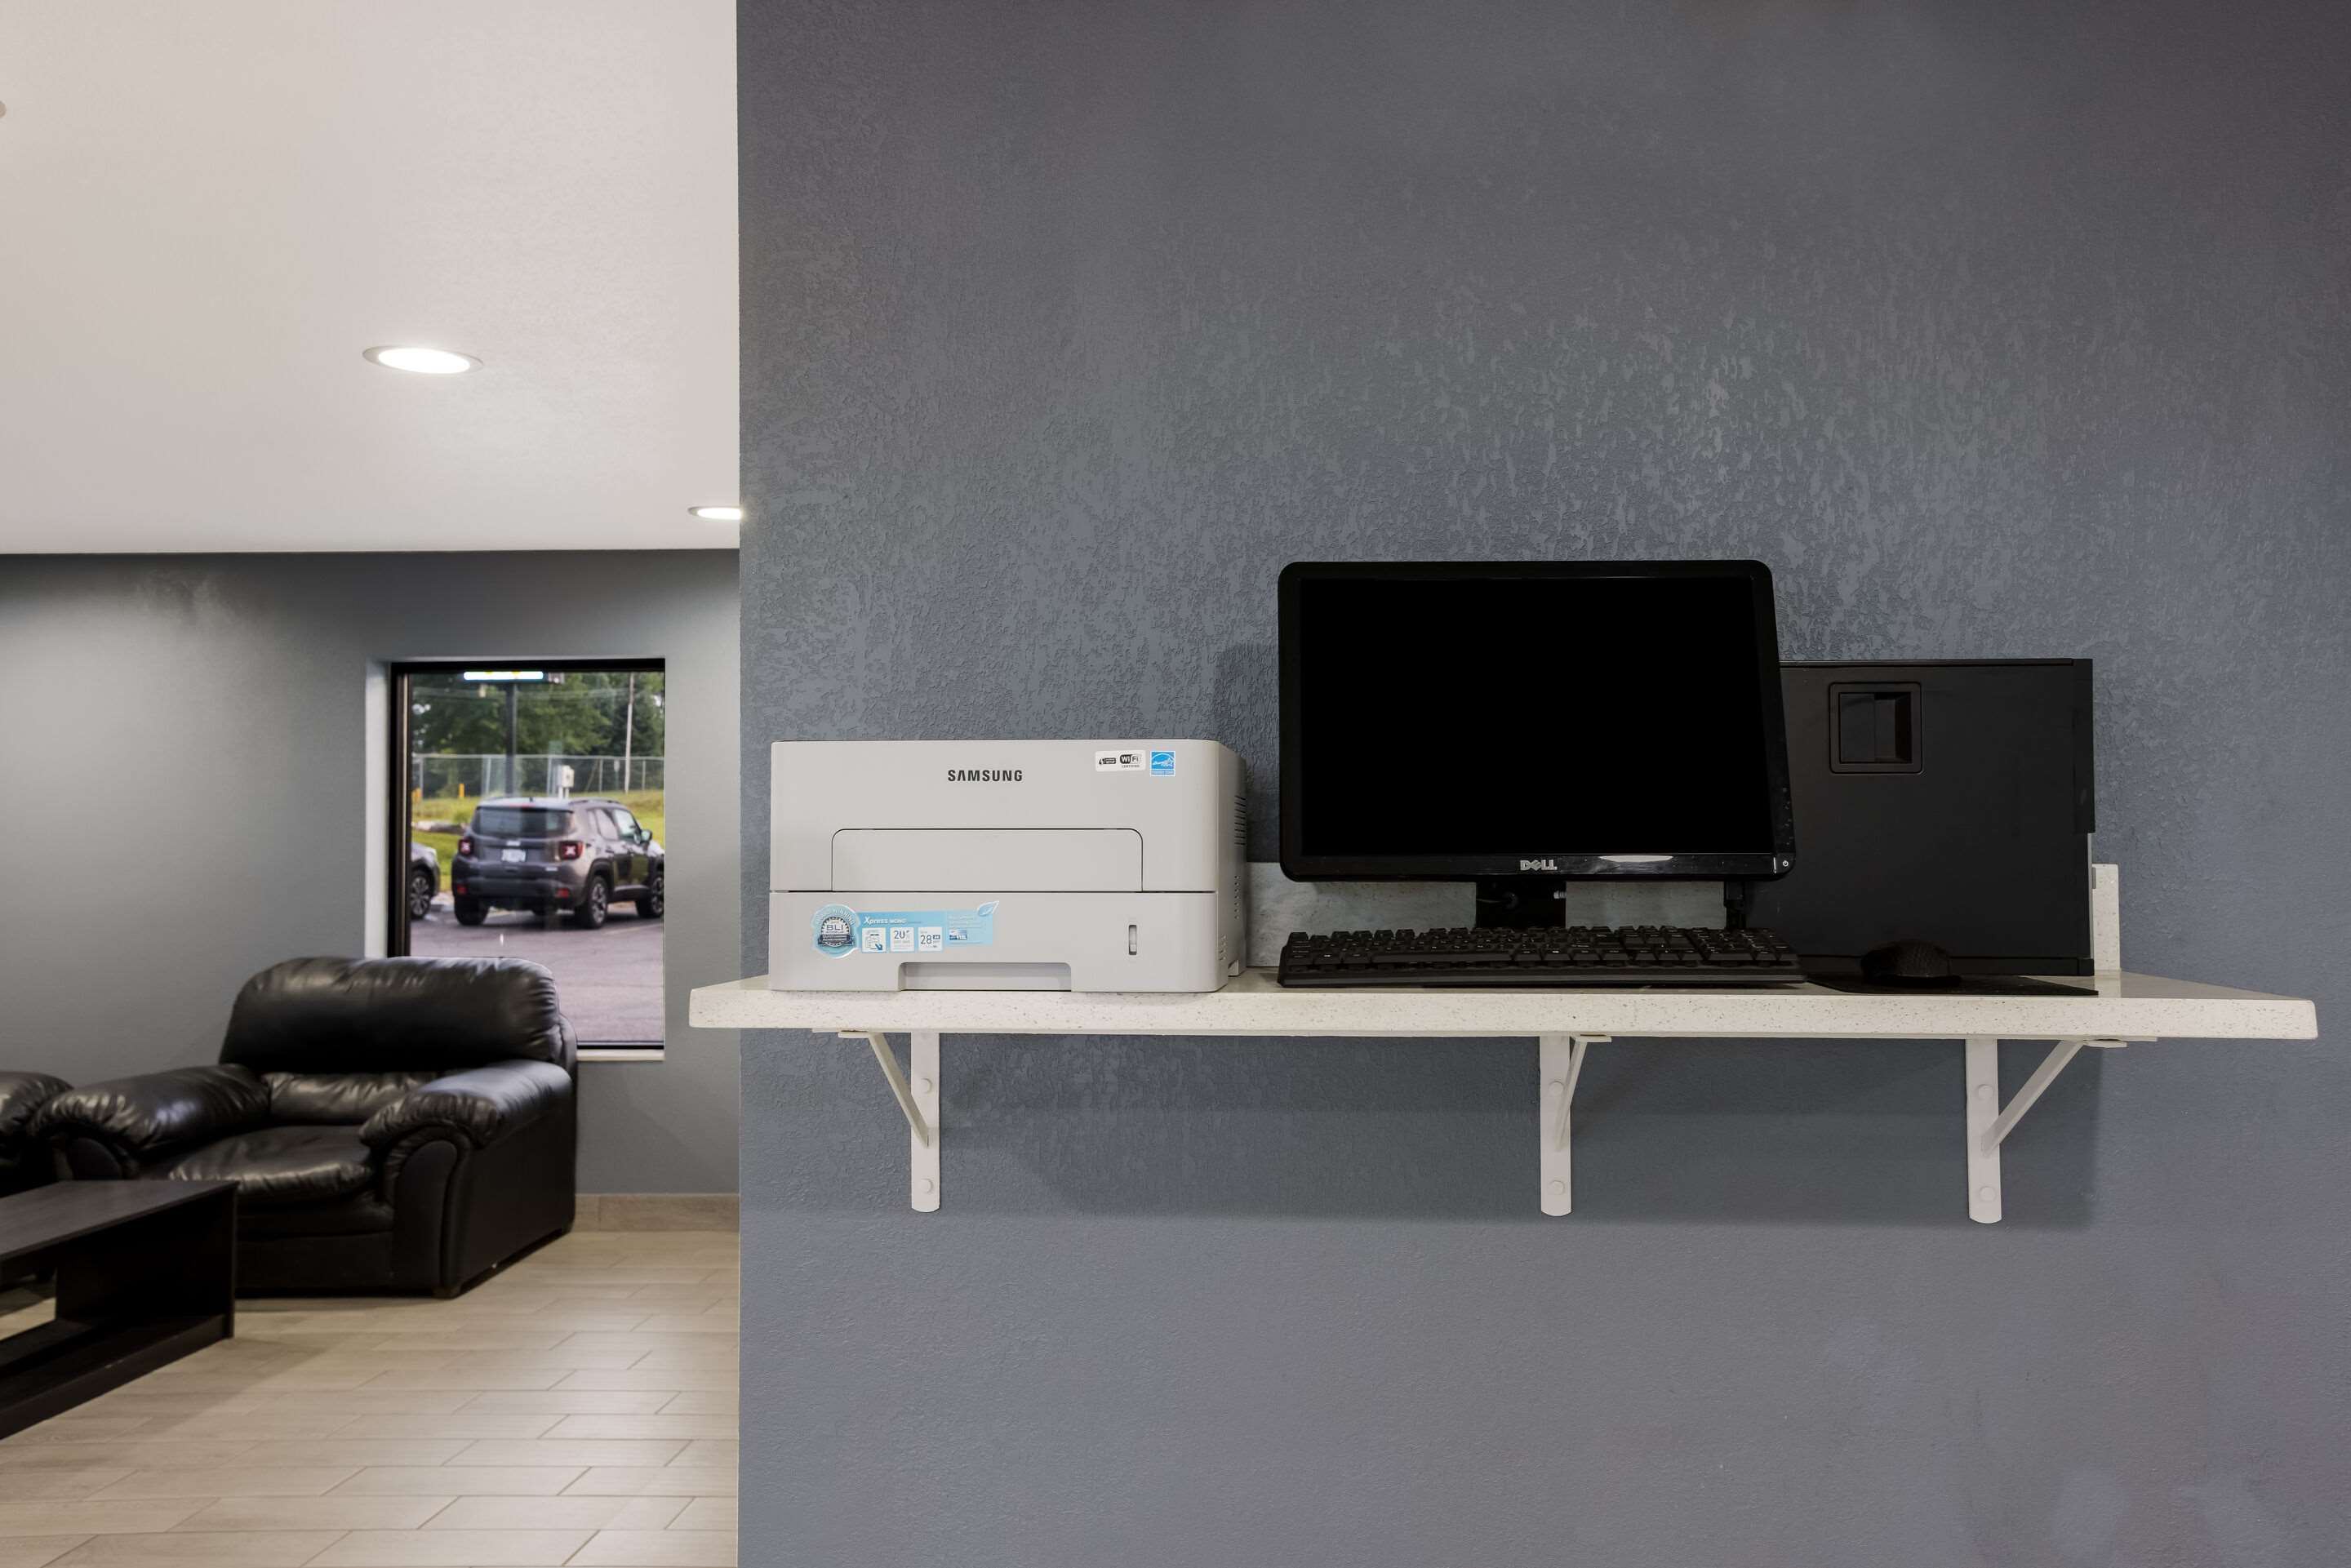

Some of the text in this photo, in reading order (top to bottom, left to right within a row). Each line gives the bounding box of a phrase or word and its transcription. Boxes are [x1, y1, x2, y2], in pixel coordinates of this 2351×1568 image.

[948, 769, 1023, 782] SAMSUNG
[1520, 860, 1558, 871] DELL
[920, 934, 932, 945] 28
